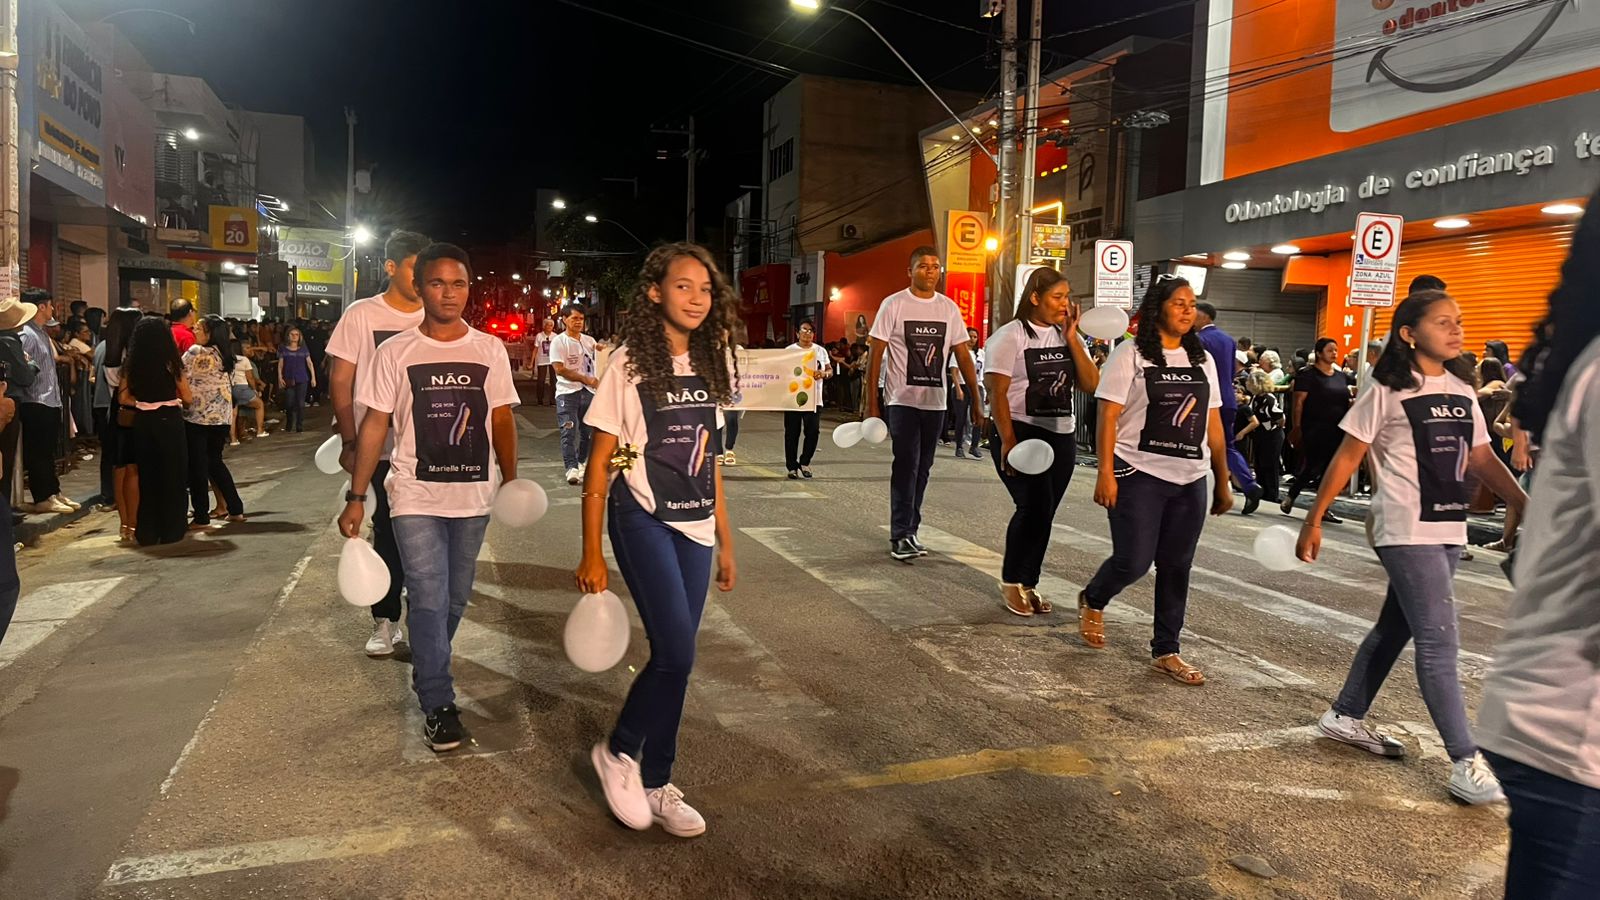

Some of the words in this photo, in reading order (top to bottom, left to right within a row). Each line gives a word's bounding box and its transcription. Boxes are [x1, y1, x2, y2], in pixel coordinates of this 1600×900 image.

[1225, 184, 1346, 223] Odontologia
[1358, 174, 1391, 199] de
[1405, 143, 1554, 190] confiança
[226, 231, 245, 244] 20
[960, 222, 976, 243] E
[1371, 230, 1384, 250] E
[1110, 251, 1118, 266] E
[304, 283, 328, 292] ÚNICO
[915, 326, 938, 334] NÃO
[1039, 352, 1064, 361] NÃO
[431, 373, 471, 385] NÃO
[1161, 373, 1192, 381] NÃO
[666, 388, 708, 404] NÃO
[1430, 405, 1466, 418] NÃO
